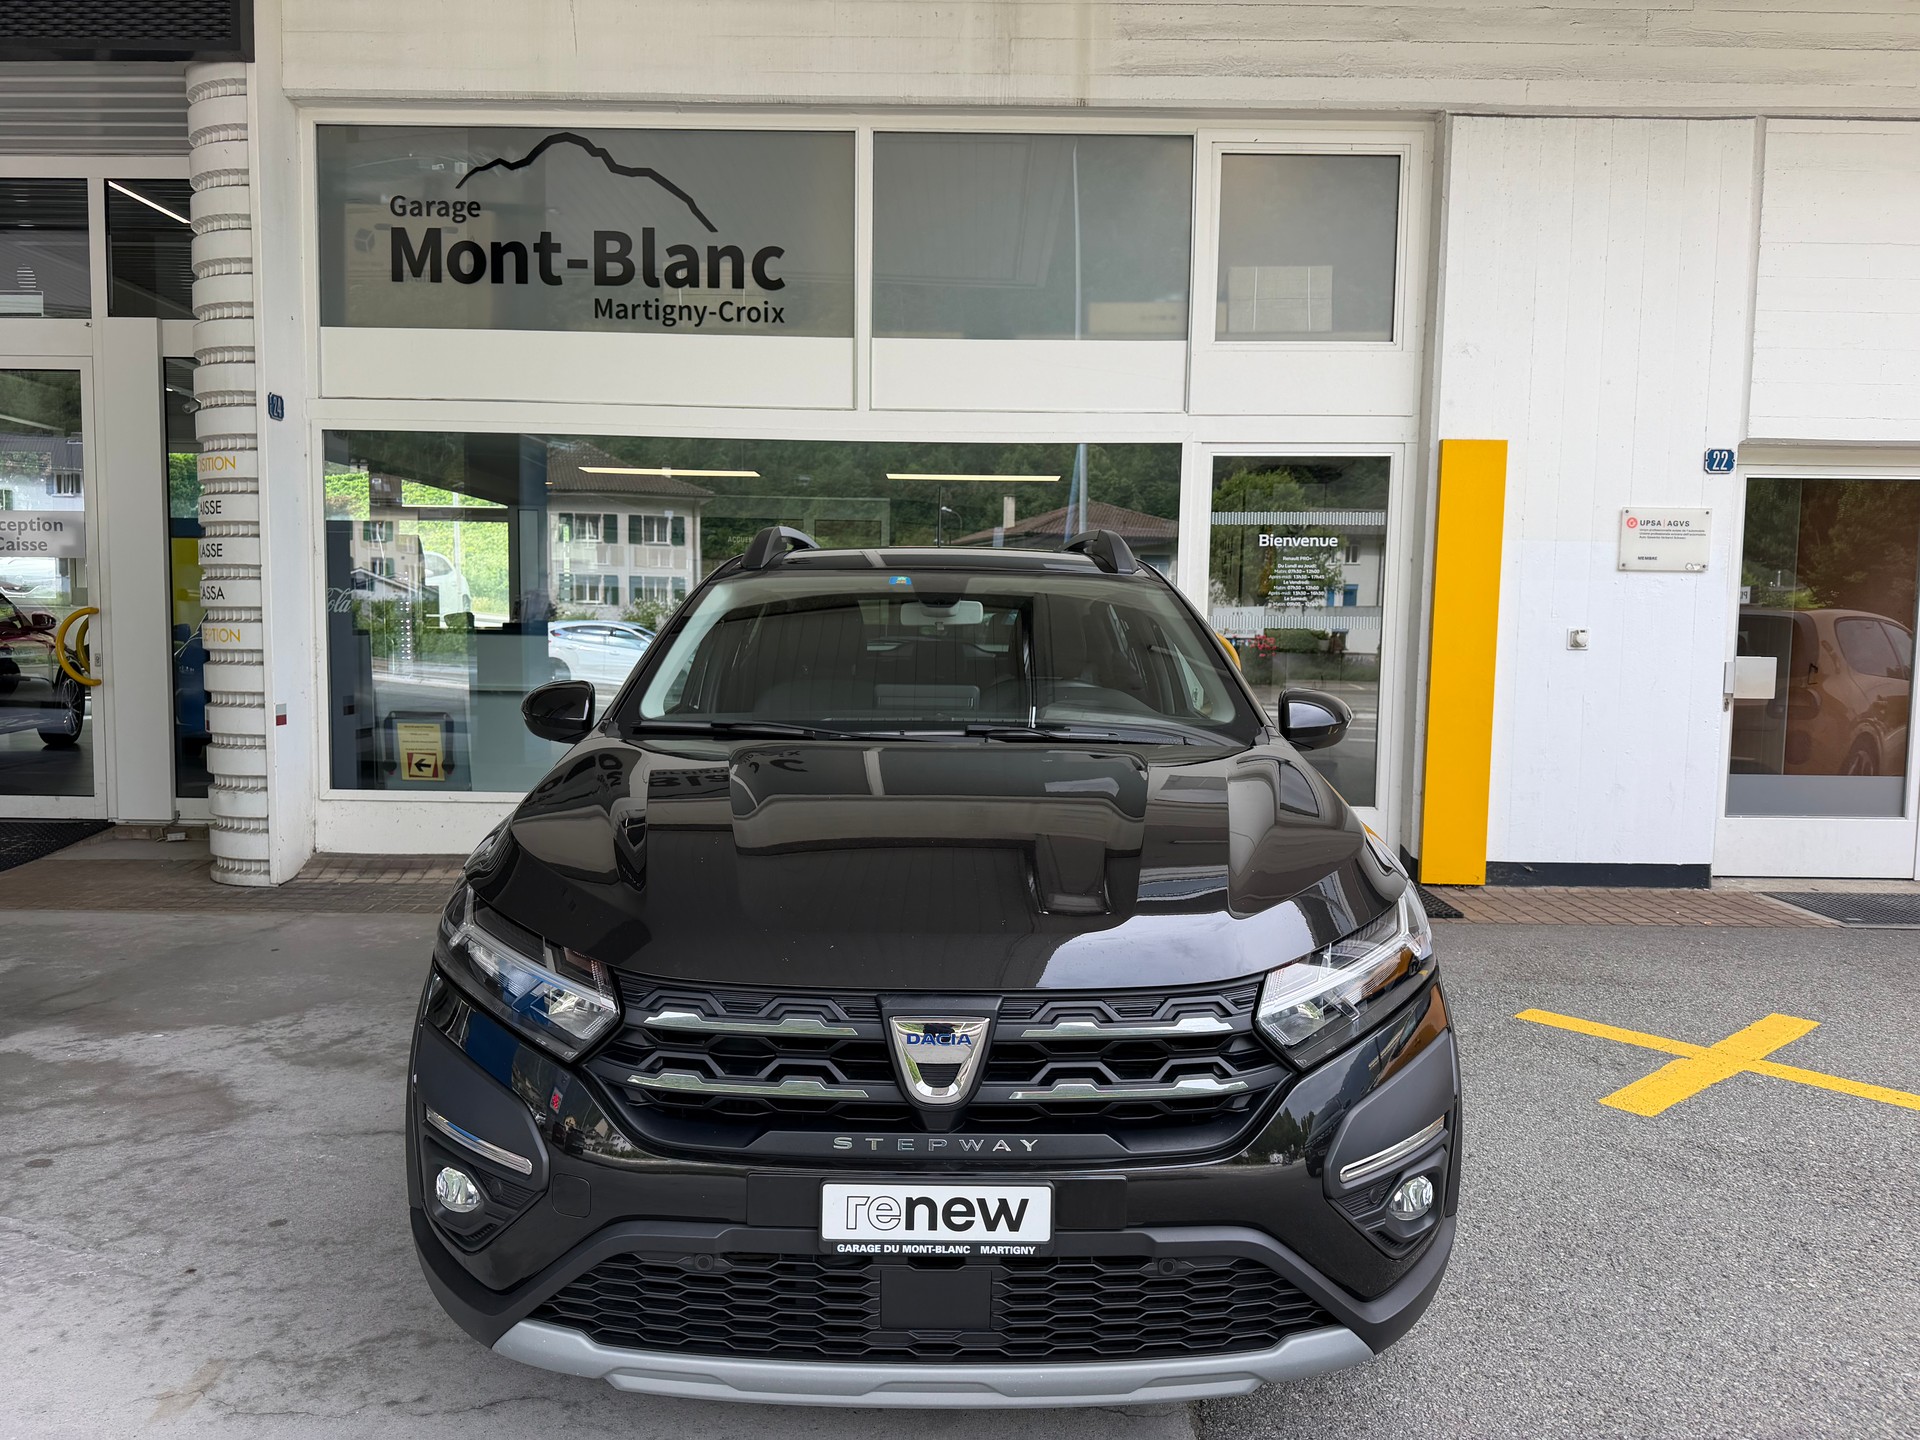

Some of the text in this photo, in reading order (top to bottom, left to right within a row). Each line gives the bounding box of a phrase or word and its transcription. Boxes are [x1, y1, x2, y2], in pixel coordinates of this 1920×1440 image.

[390, 195, 481, 224] Garage
[389, 226, 786, 290] Mont-Blanc
[594, 297, 786, 328] Martigny-Croix
[1712, 450, 1729, 471] 22
[1258, 534, 1338, 547] Bienvenue
[906, 1032, 972, 1047] DACIA
[833, 1136, 1040, 1153] STEPWAY
[846, 1195, 1030, 1232] renew
[837, 1244, 1036, 1255] GARAGE DU MONT-BLANC MARTIGNY
